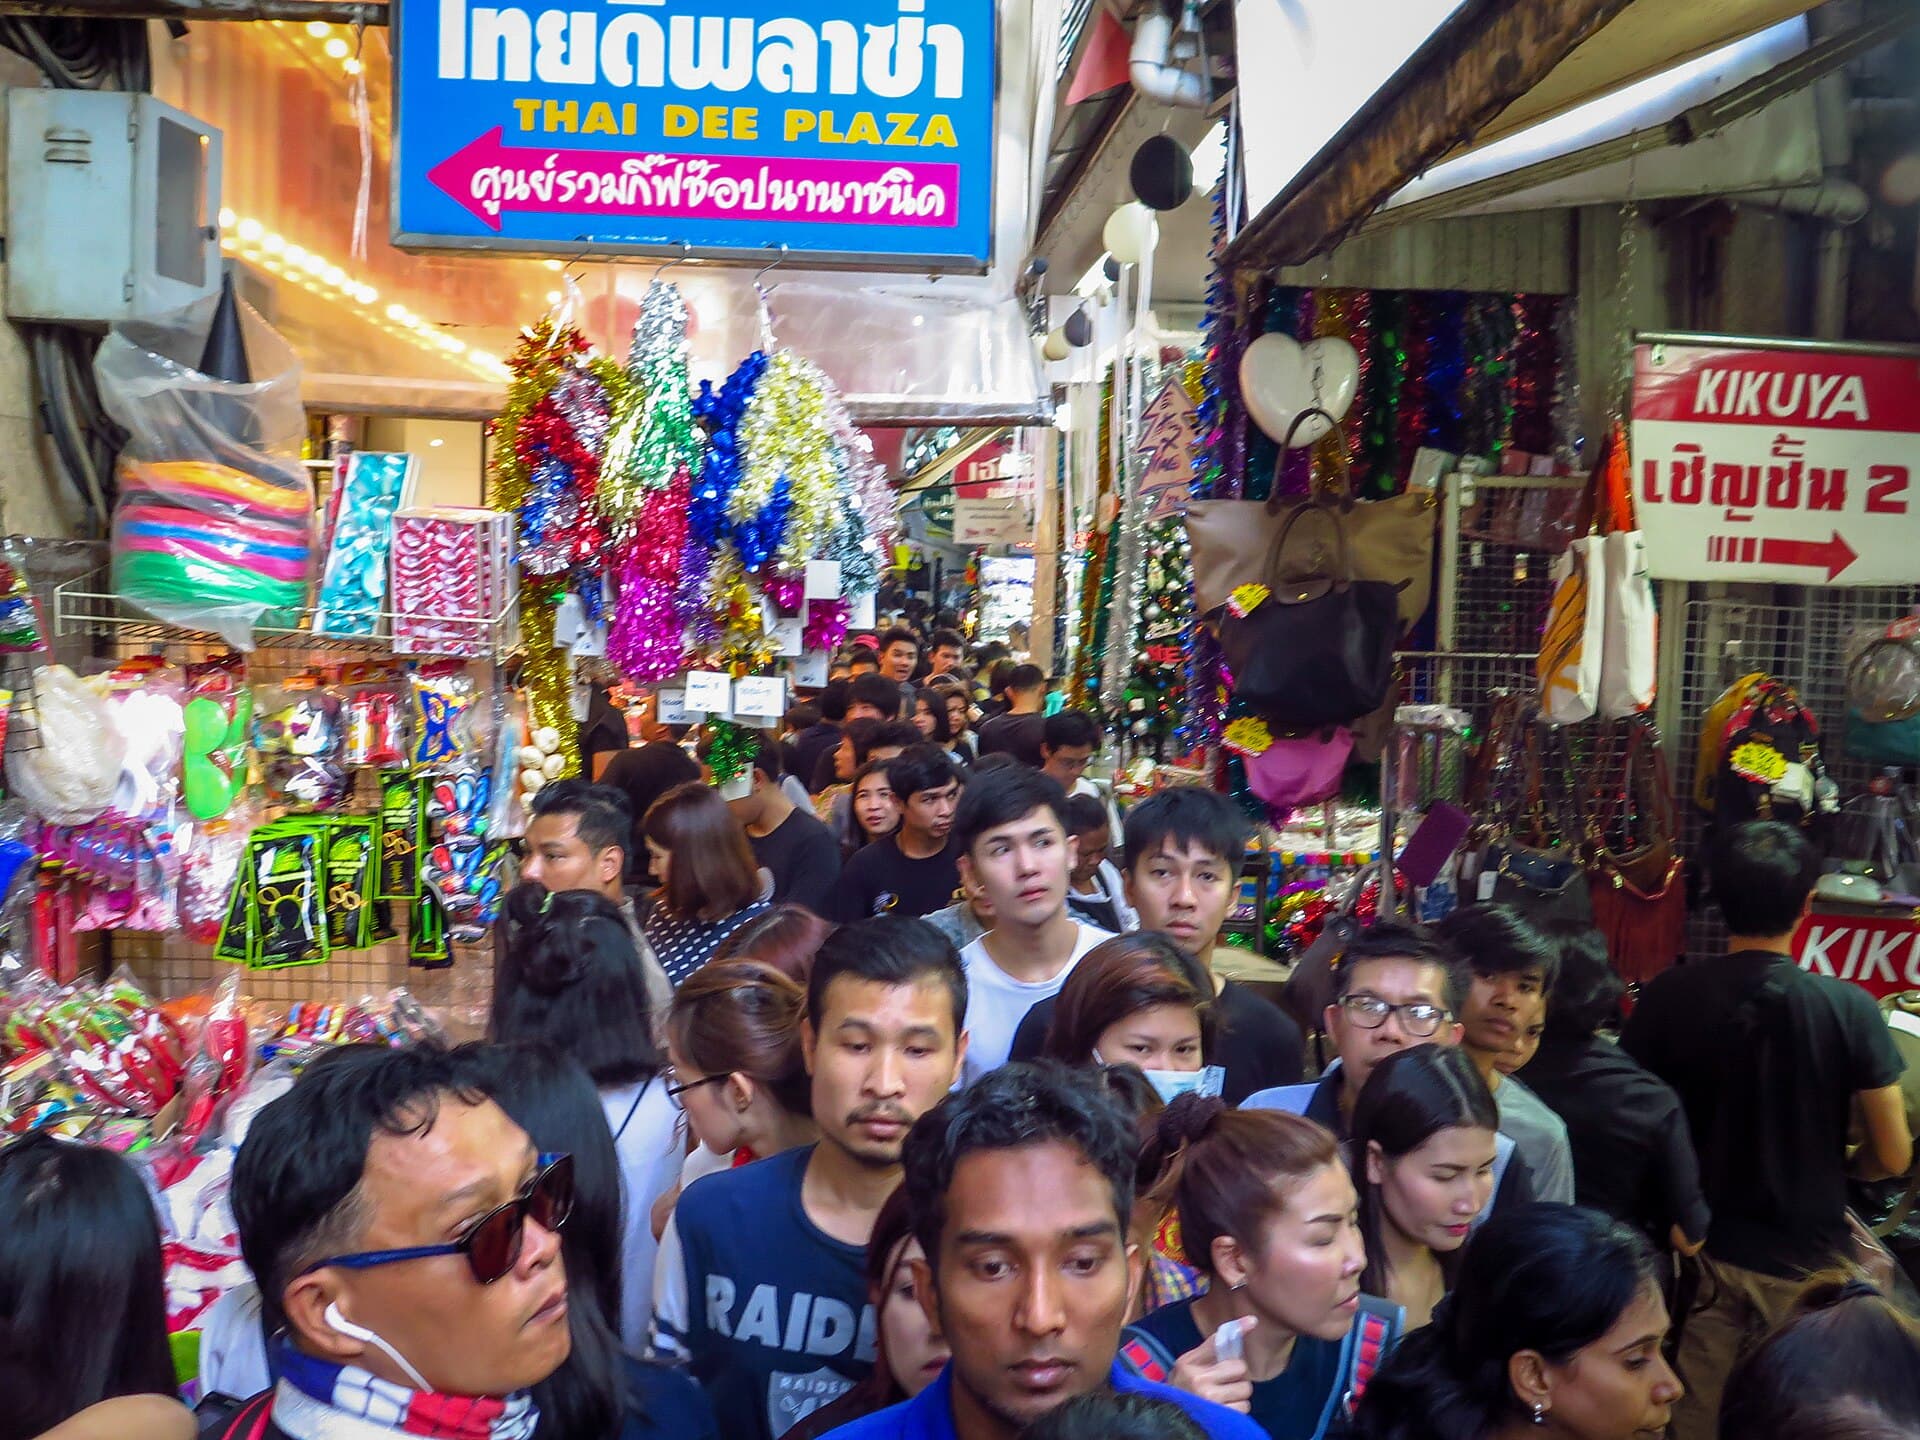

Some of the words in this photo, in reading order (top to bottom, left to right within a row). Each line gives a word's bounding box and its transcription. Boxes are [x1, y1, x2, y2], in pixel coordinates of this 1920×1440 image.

[438, 0, 964, 99] ไทยดพลาซ่า
[513, 98, 637, 135] THAI
[663, 104, 758, 140] DEE
[784, 108, 959, 148] PLAZA
[1693, 368, 1870, 422] KIKUYA
[1642, 433, 1849, 522] เชิญชั้น
[1864, 464, 1910, 514] 2
